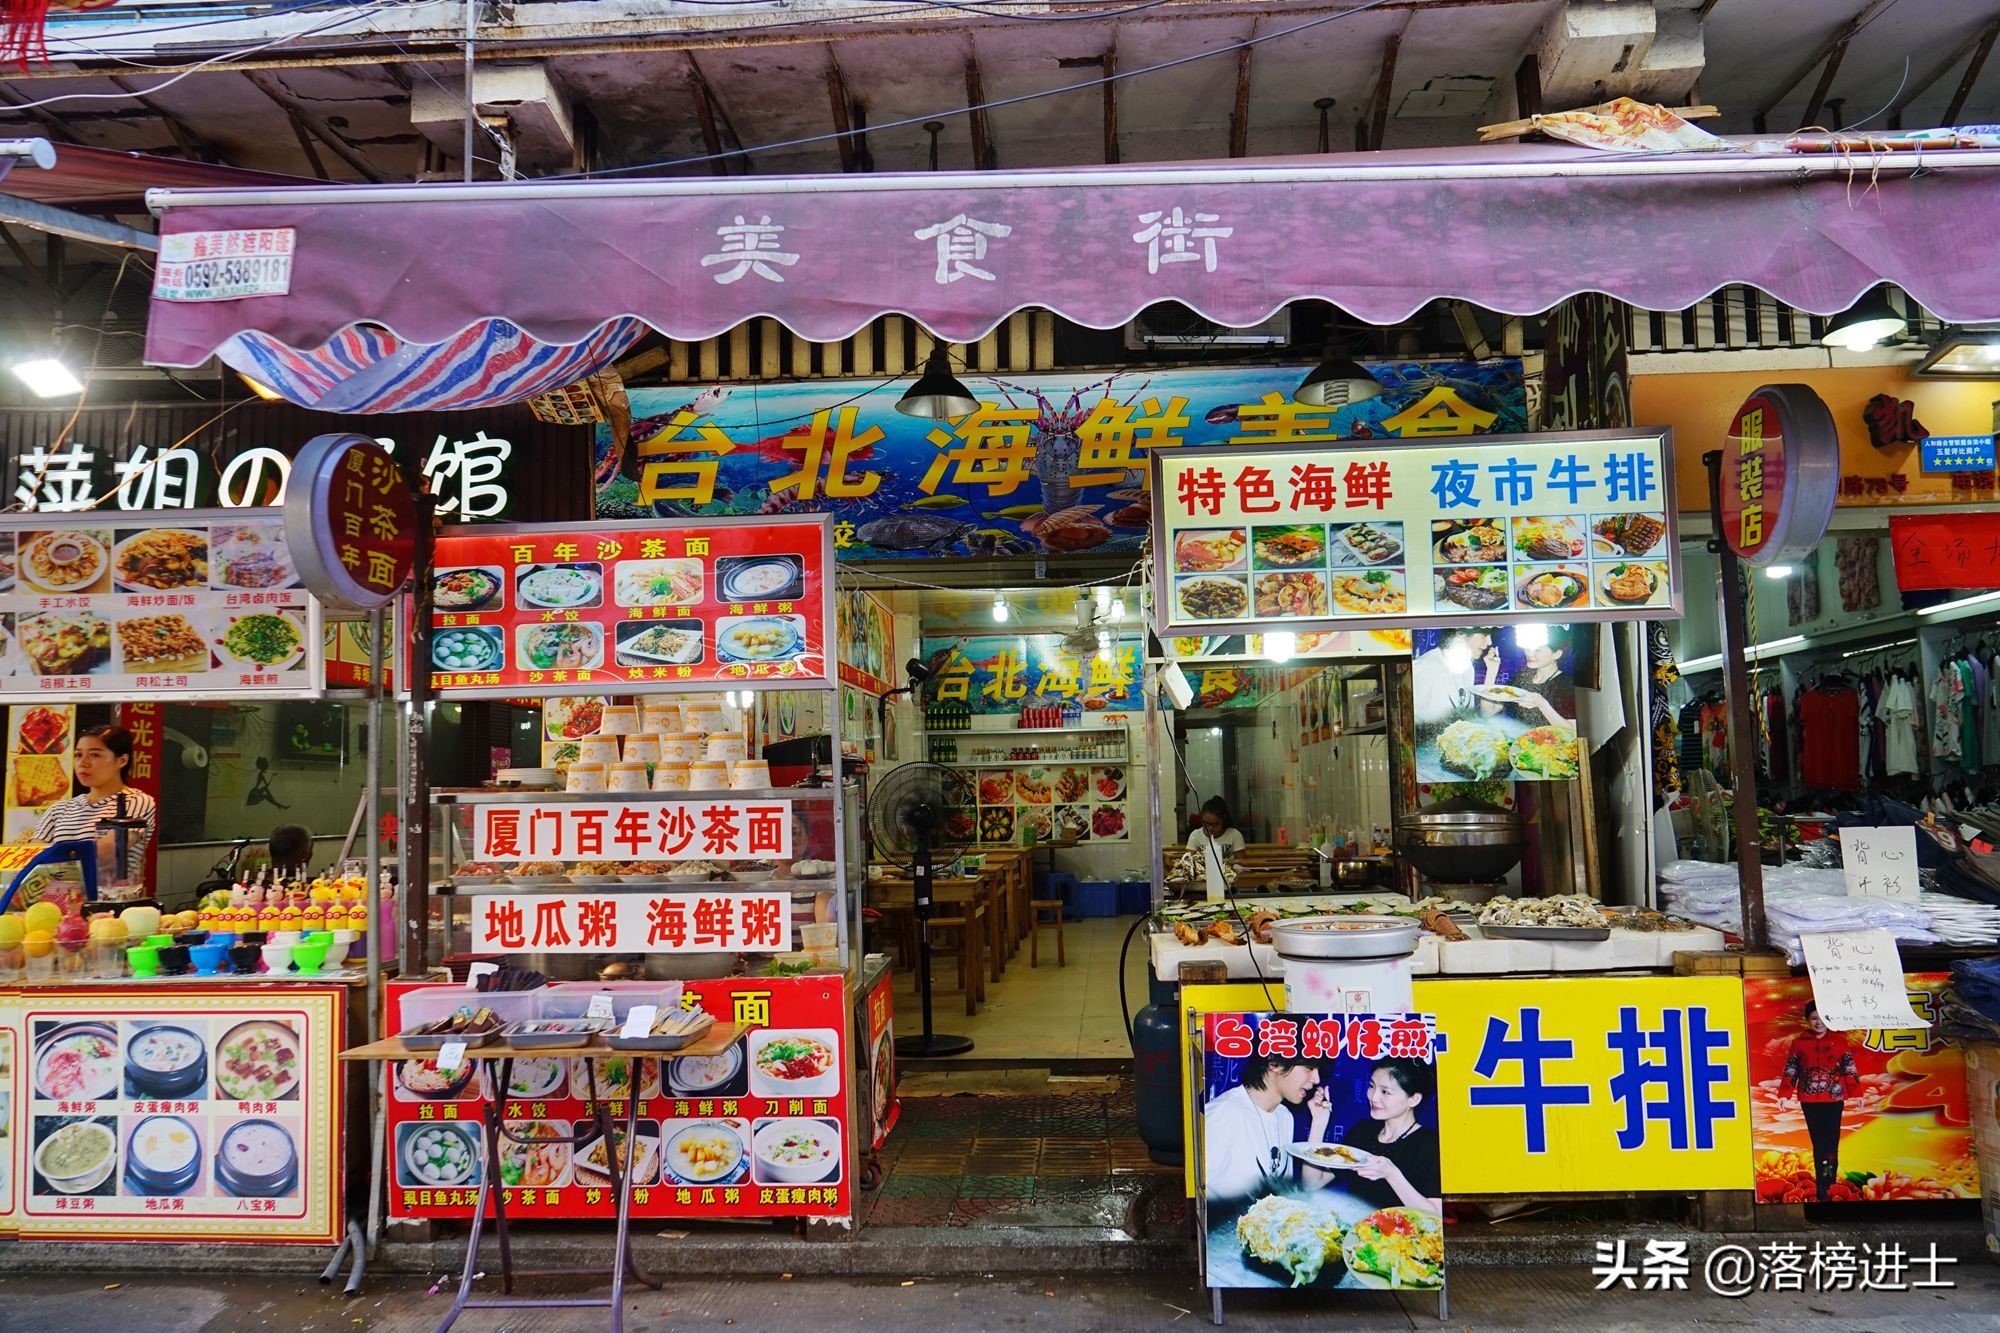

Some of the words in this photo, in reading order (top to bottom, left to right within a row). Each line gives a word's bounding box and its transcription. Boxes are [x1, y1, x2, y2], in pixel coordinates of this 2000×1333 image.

[699, 206, 1234, 284] 美食街
[185, 259, 289, 288] 0592-5389181
[1177, 461, 1394, 516] 特色海鲜
[1431, 452, 1656, 509] 夜市牛排
[1738, 407, 1764, 548] 服装店
[340, 448, 366, 571] 厦门百年
[367, 456, 403, 589] 沙茶面
[509, 537, 711, 563] 百年沙茶面
[39, 597, 91, 608] 手工水饺
[127, 594, 196, 607] 海鲜炒面/饭
[226, 592, 292, 605] 台湾卤肉饭
[541, 609, 580, 622] 水饺
[628, 606, 692, 619] 海鲜面
[729, 602, 793, 615] 海鲜粥
[442, 613, 481, 626] 拉面
[239, 674, 278, 686] 海蛎煎
[529, 669, 592, 683] 沙茶面
[628, 666, 693, 680] 炒米粉
[40, 677, 92, 689] 培根土司
[136, 675, 188, 687] 肉松土司
[484, 805, 785, 858] 厦门百年沙茶面
[1850, 839, 1904, 865] 背心
[485, 899, 618, 949] 地瓜粥
[646, 897, 782, 949] 海鲜粥
[1215, 1018, 1430, 1060] 台湾蚵仔煎
[1469, 1005, 1737, 1155] 牛排
[57, 1102, 97, 1113] 海鲜粥
[133, 1102, 199, 1113] 皮蛋瘦肉粥
[238, 1102, 278, 1114] 鸭肉粥
[419, 1103, 459, 1120] 拉面
[507, 1103, 547, 1118] 水饺
[674, 1101, 738, 1116] 海鲜粥
[765, 1099, 828, 1115] 刀削面
[586, 1188, 649, 1205] 炒粉
[676, 1188, 740, 1204] 地瓜粥
[759, 1187, 838, 1205] 皮蛋瘦肉粥
[55, 1199, 95, 1210] 绿豆粥
[145, 1199, 184, 1210] 地瓜粥
[237, 1200, 277, 1211] 八宝粥
